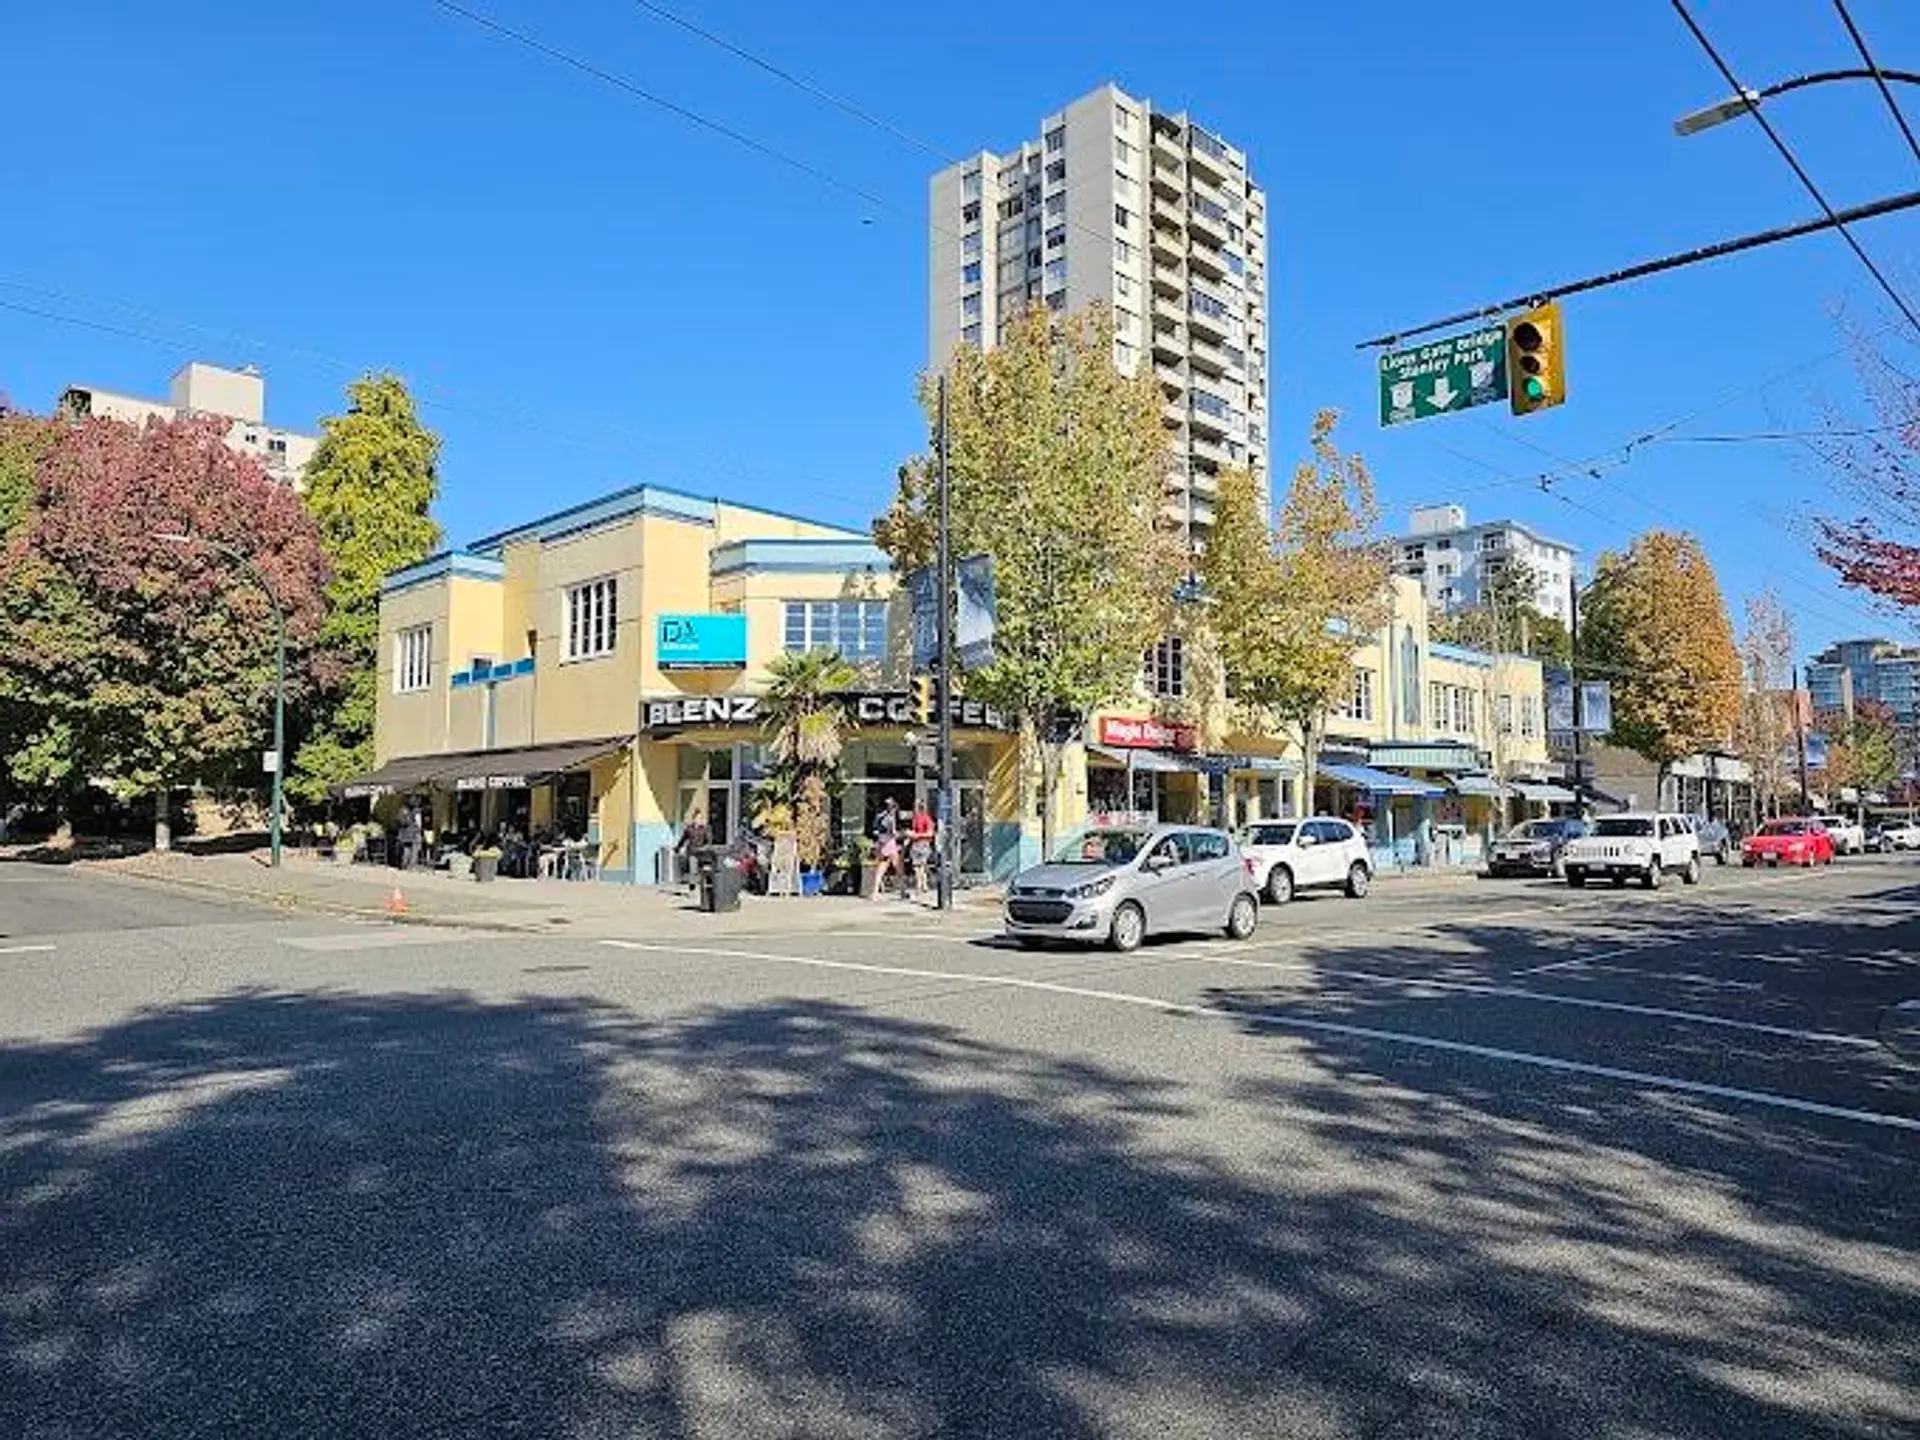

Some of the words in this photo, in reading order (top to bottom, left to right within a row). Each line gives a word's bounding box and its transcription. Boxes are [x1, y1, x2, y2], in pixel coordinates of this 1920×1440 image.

[1382, 354, 1416, 370] Lions
[1420, 343, 1452, 359] Gate
[1456, 330, 1503, 351] Bridge
[1399, 358, 1450, 379] Stanley
[1454, 348, 1484, 365] Park
[650, 697, 760, 724] BLENZ
